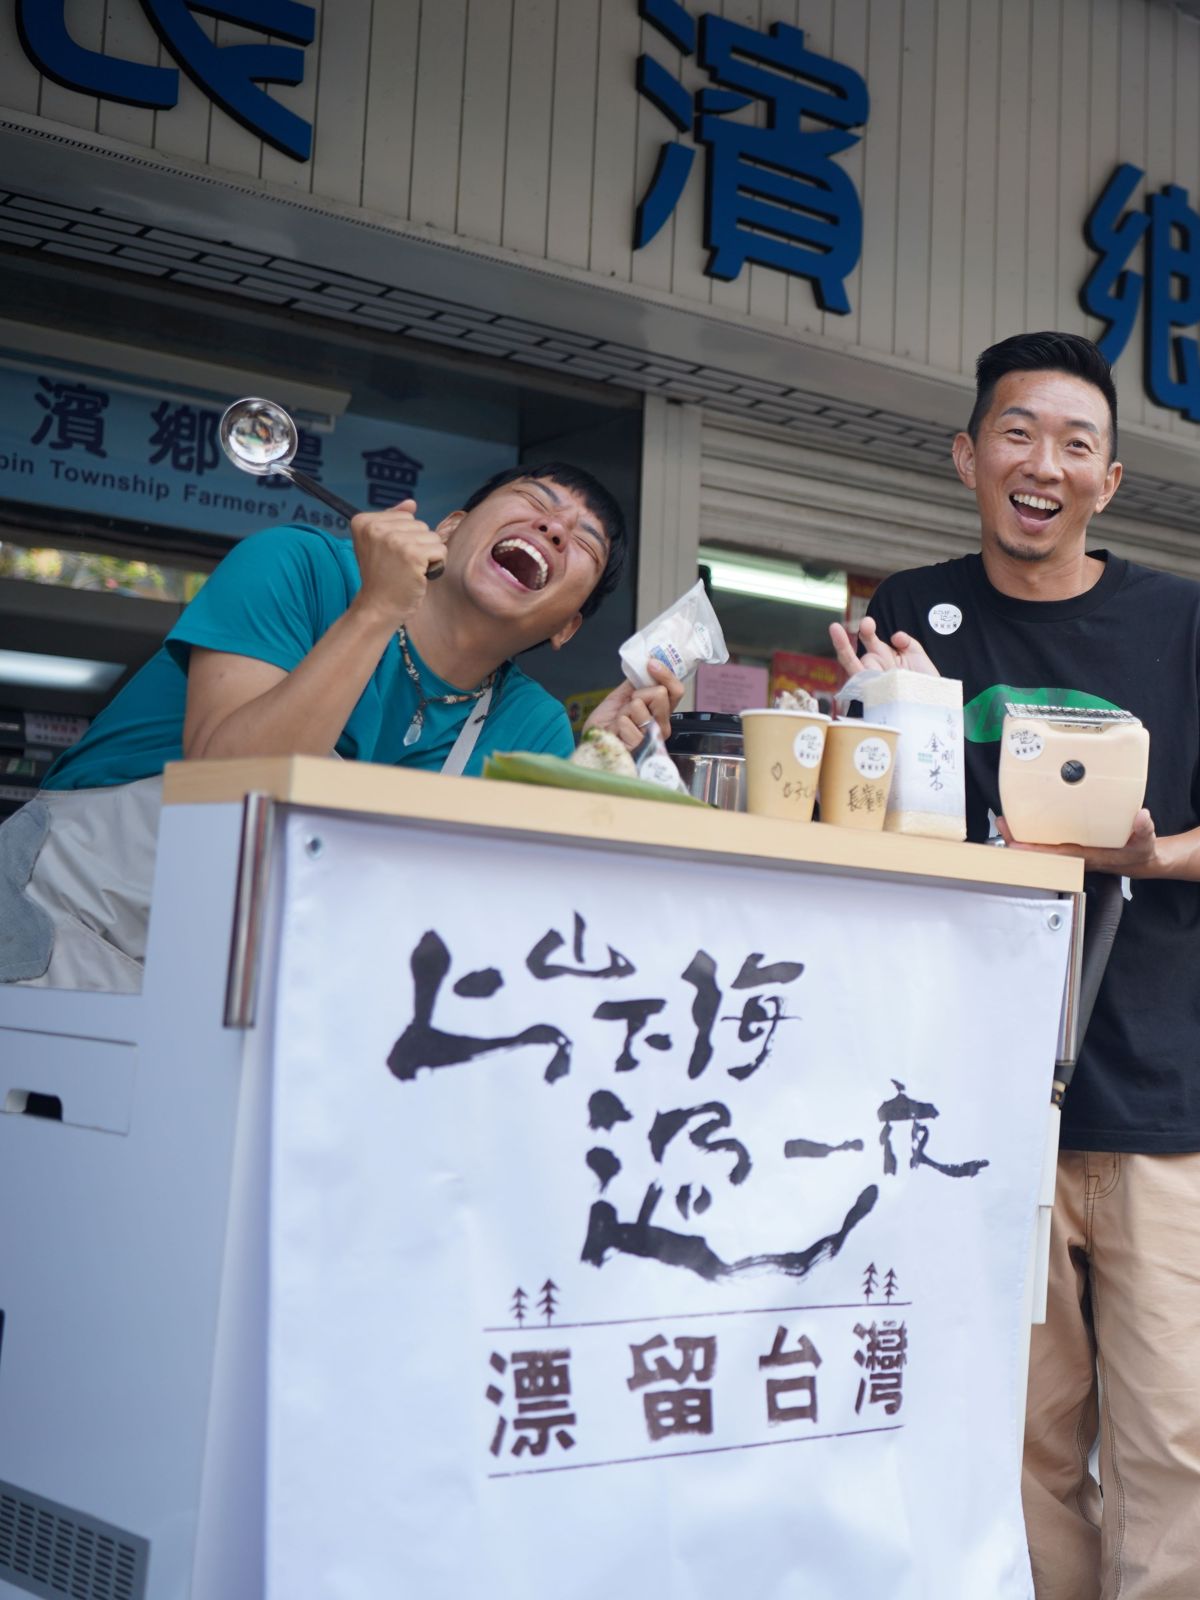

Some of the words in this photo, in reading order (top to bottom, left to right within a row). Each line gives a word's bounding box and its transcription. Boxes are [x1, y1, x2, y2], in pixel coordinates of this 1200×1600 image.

[50, 458, 170, 501] Township
[183, 488, 288, 519] Farmers'
[292, 503, 349, 531] Asso
[386, 910, 806, 1084] 上山下海
[485, 1319, 909, 1458] 漂留台灣
